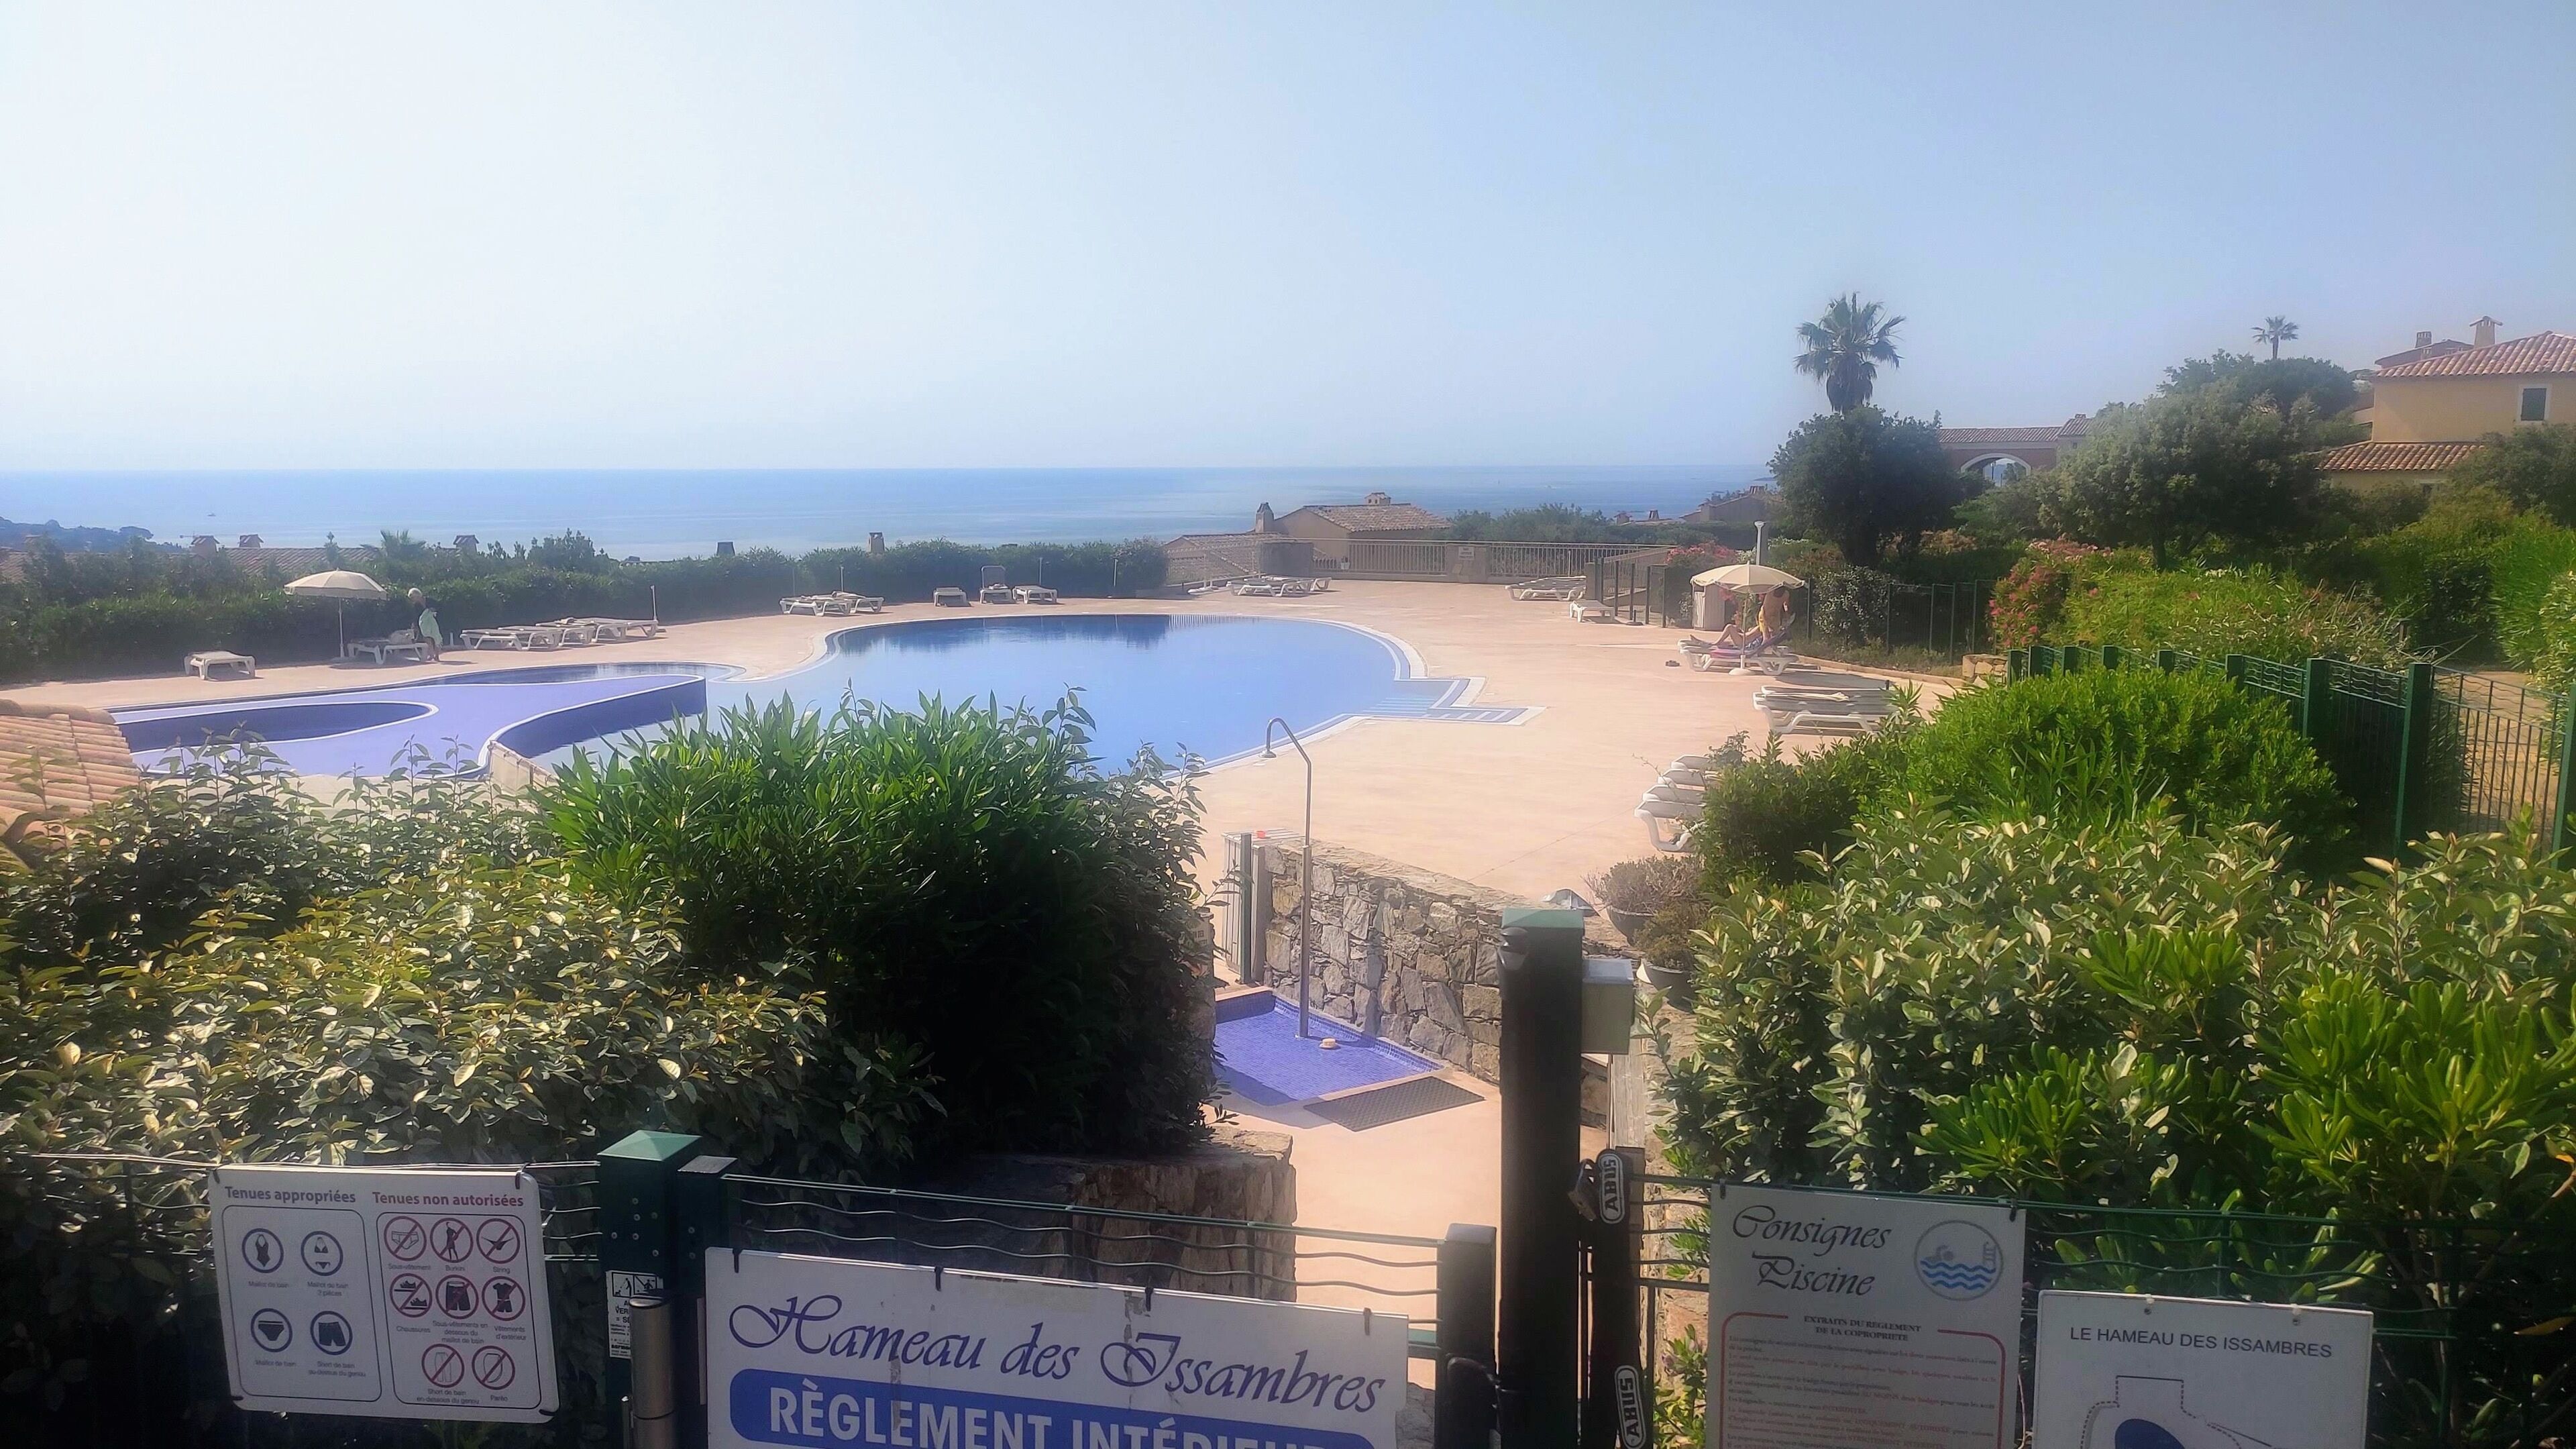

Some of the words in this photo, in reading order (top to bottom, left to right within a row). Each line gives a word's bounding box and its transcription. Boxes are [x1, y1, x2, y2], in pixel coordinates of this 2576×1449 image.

[225, 1186, 270, 1199] Tenues
[274, 1189, 356, 1205] appropriées
[372, 1191, 419, 1205] Tenues
[424, 1195, 449, 1205] non
[453, 1193, 524, 1207] autorisées
[1604, 1159, 1618, 1212] ABUS
[1733, 1205, 1892, 1256] Consignes
[1752, 1250, 1876, 1296] Piscine
[1804, 1316, 1847, 1326] EXTRAITS
[1849, 1319, 1864, 1327] DU
[1866, 1320, 1921, 1332] REGLEMENT
[1844, 1329, 1909, 1341] COPROPRIETE
[2070, 1326, 2092, 1340] LE
[2098, 1328, 2174, 1346] HAMEAU
[2180, 1334, 2217, 1350] DES
[2223, 1336, 2332, 1358] ISSAMBRES
[729, 1295, 987, 1370] Hameau
[1000, 1322, 1080, 1380] des
[1100, 1332, 1386, 1413] Issambres
[770, 1377, 1052, 1449] RÈGLEMENT
[1620, 1378, 1640, 1437] ABUS
